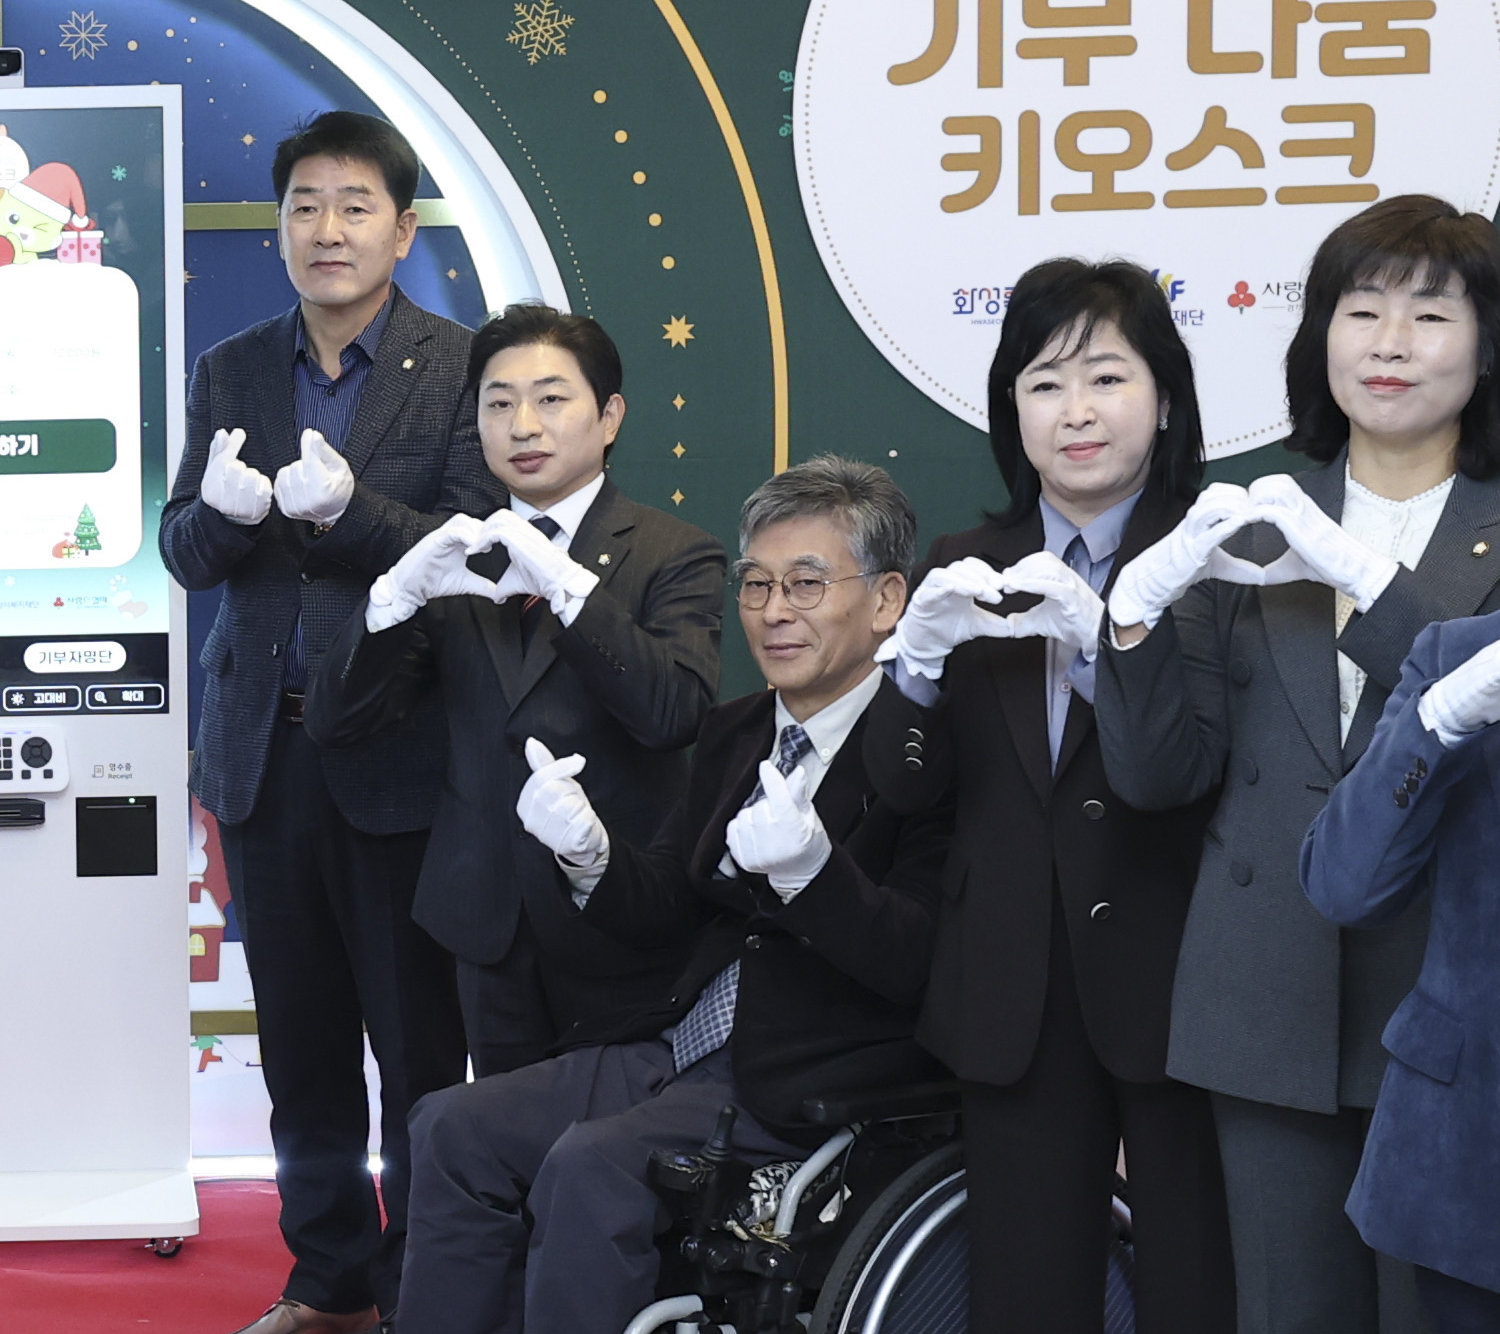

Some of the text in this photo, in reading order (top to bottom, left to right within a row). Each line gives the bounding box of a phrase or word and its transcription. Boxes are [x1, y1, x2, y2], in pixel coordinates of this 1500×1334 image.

[940, 103, 1380, 216] 키오스크
[39, 650, 113, 665] 기부자명단
[34, 692, 66, 704] 고대비
[122, 690, 144, 702] 확대
[109, 763, 132, 772] 영수증
[108, 772, 133, 780] Receipt
